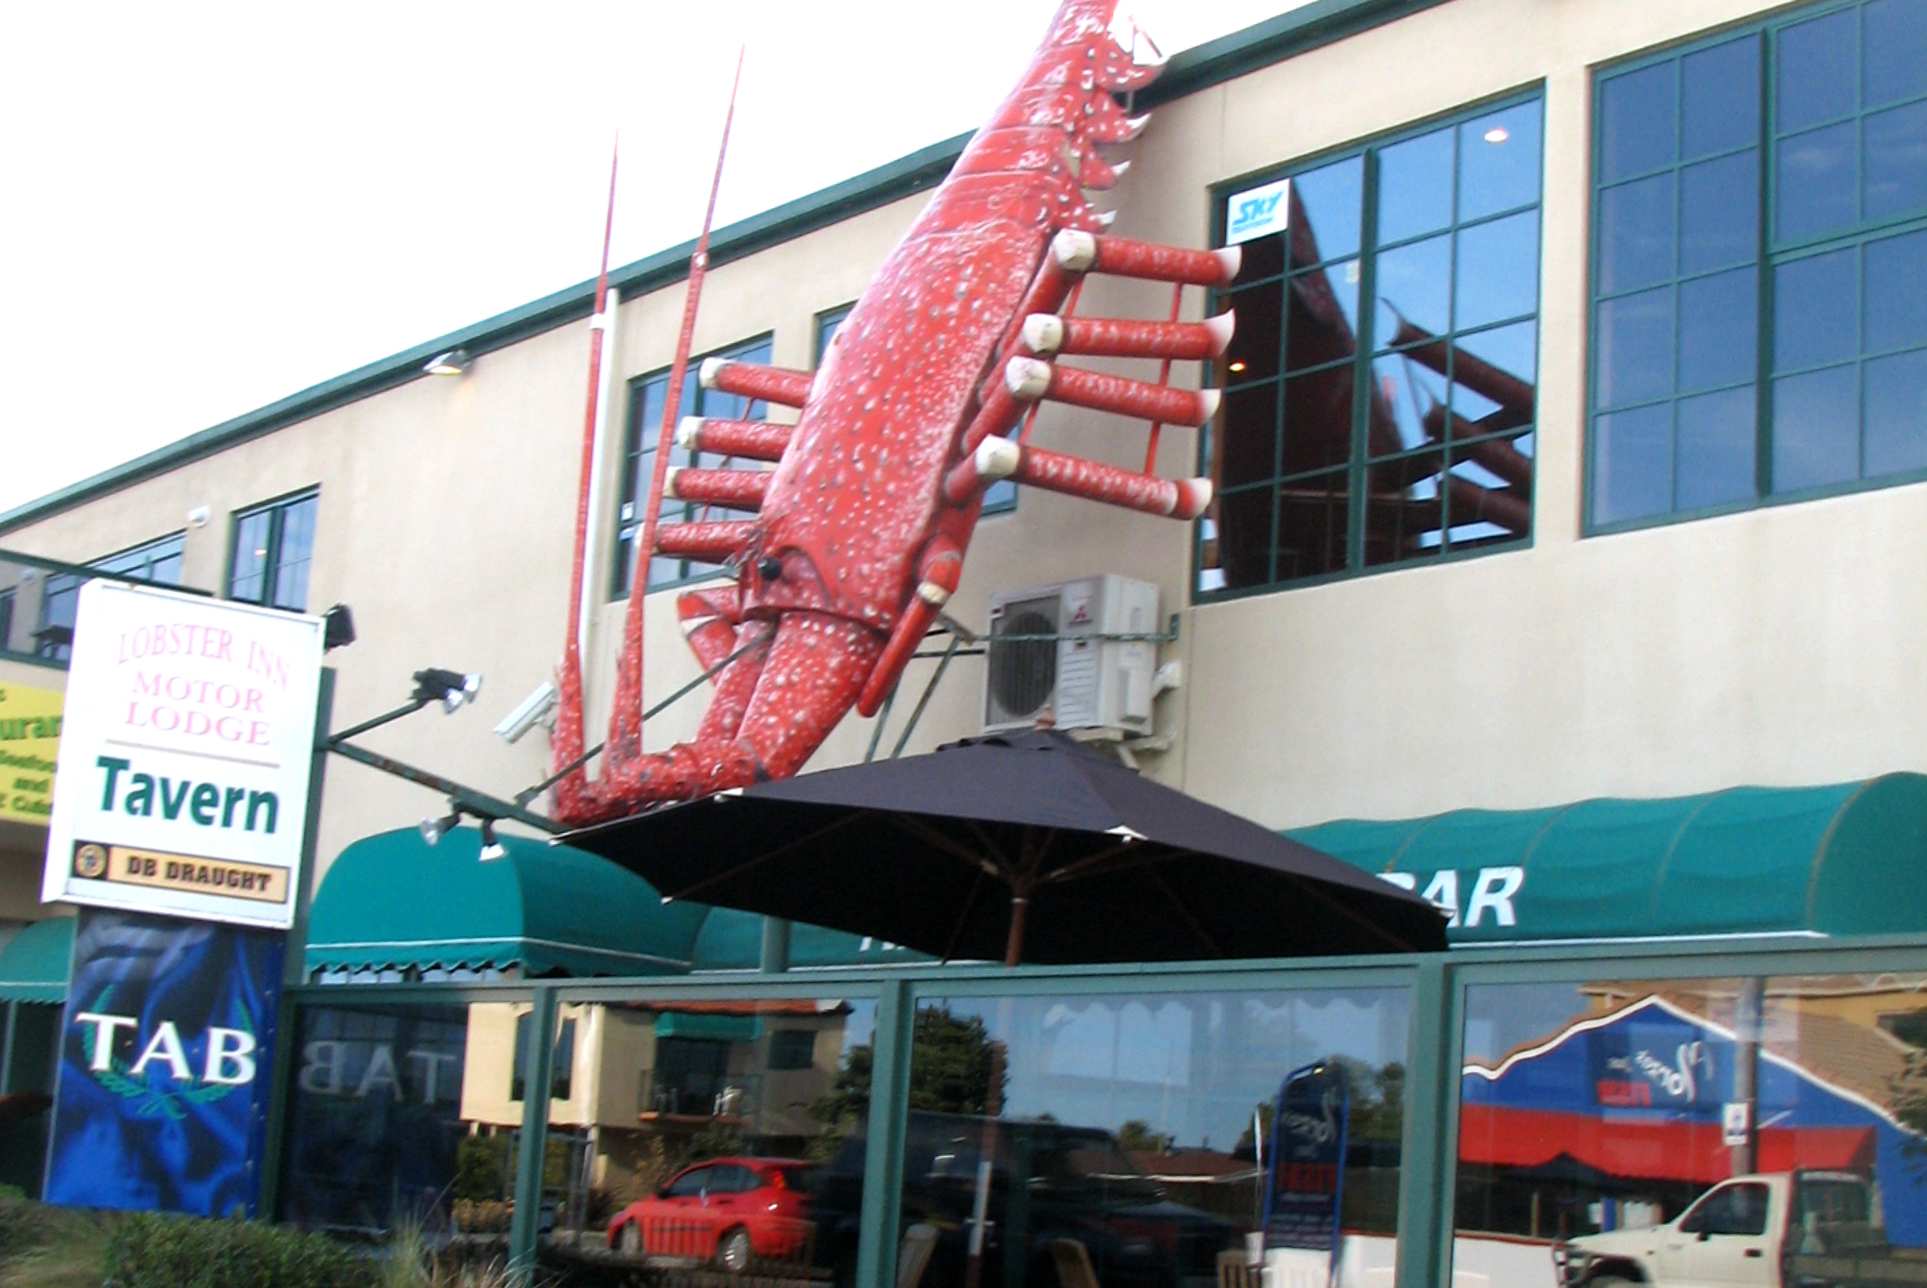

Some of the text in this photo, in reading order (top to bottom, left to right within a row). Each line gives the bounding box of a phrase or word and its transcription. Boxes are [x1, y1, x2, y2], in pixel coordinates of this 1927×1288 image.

[1233, 190, 1284, 226] SKY
[118, 622, 292, 690] LOBSTER INN
[132, 670, 264, 713] MOTOR
[125, 700, 271, 747] LODGE
[96, 755, 280, 834] Tavern
[126, 854, 273, 893] DB DRAUGHT
[74, 1011, 257, 1085] TAB
